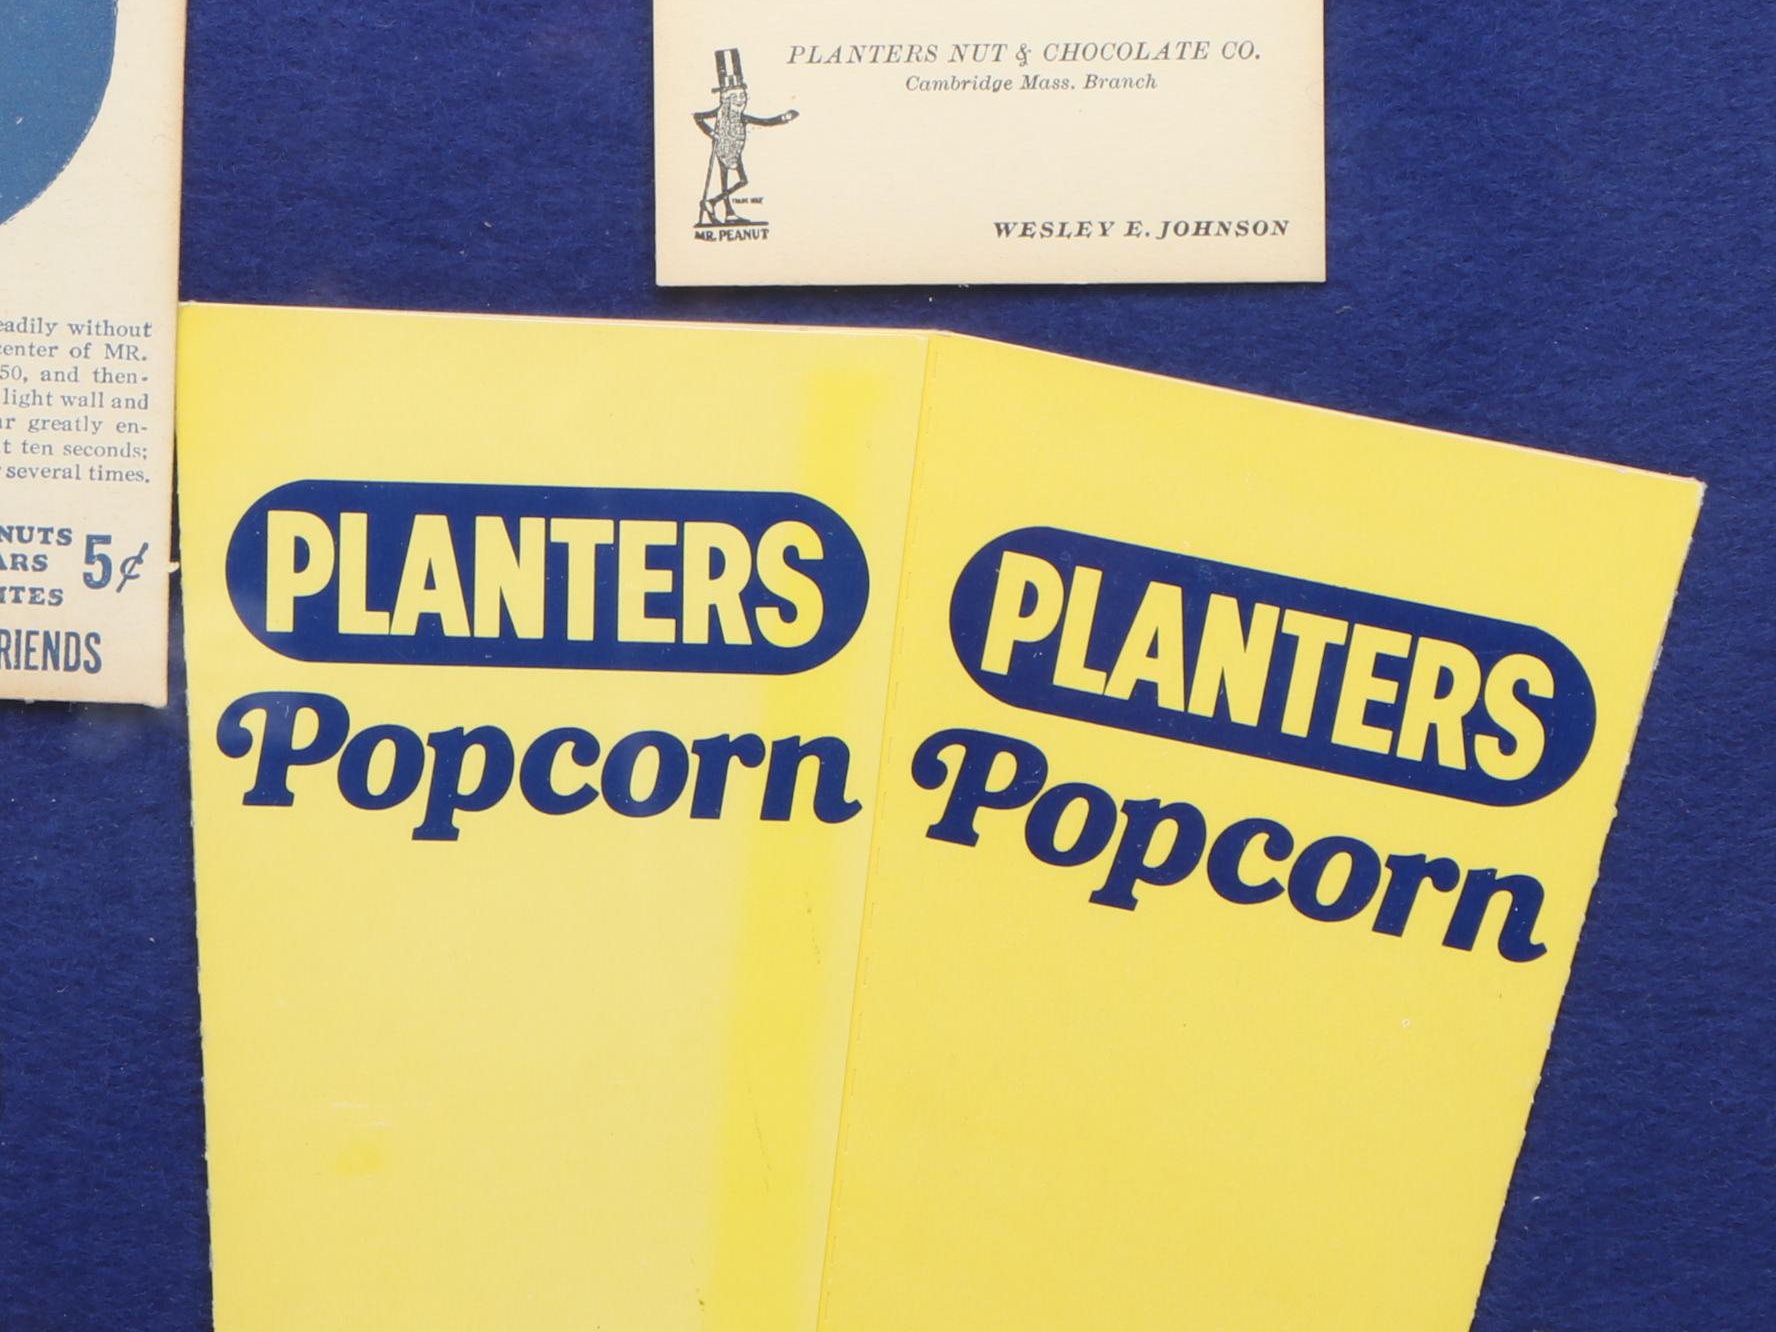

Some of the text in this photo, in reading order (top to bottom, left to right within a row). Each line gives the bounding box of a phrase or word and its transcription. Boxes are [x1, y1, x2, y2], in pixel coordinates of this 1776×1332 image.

[786, 40, 1261, 68] PLANTERS NUT & CHOCOLATE CO.
[905, 72, 1158, 93] Cambridge Mass. Branch
[719, 228, 770, 242] PEANUT
[993, 219, 1290, 241] WESLEY E. JOHNSON
[66, 319, 153, 338] without
[68, 341, 93, 360] of
[104, 342, 148, 362] MR.
[265, 508, 826, 650] PLANTERS
[981, 548, 1559, 785] PLANTERS
[215, 691, 863, 842] Popcorn
[909, 727, 1548, 964] Popcorn
